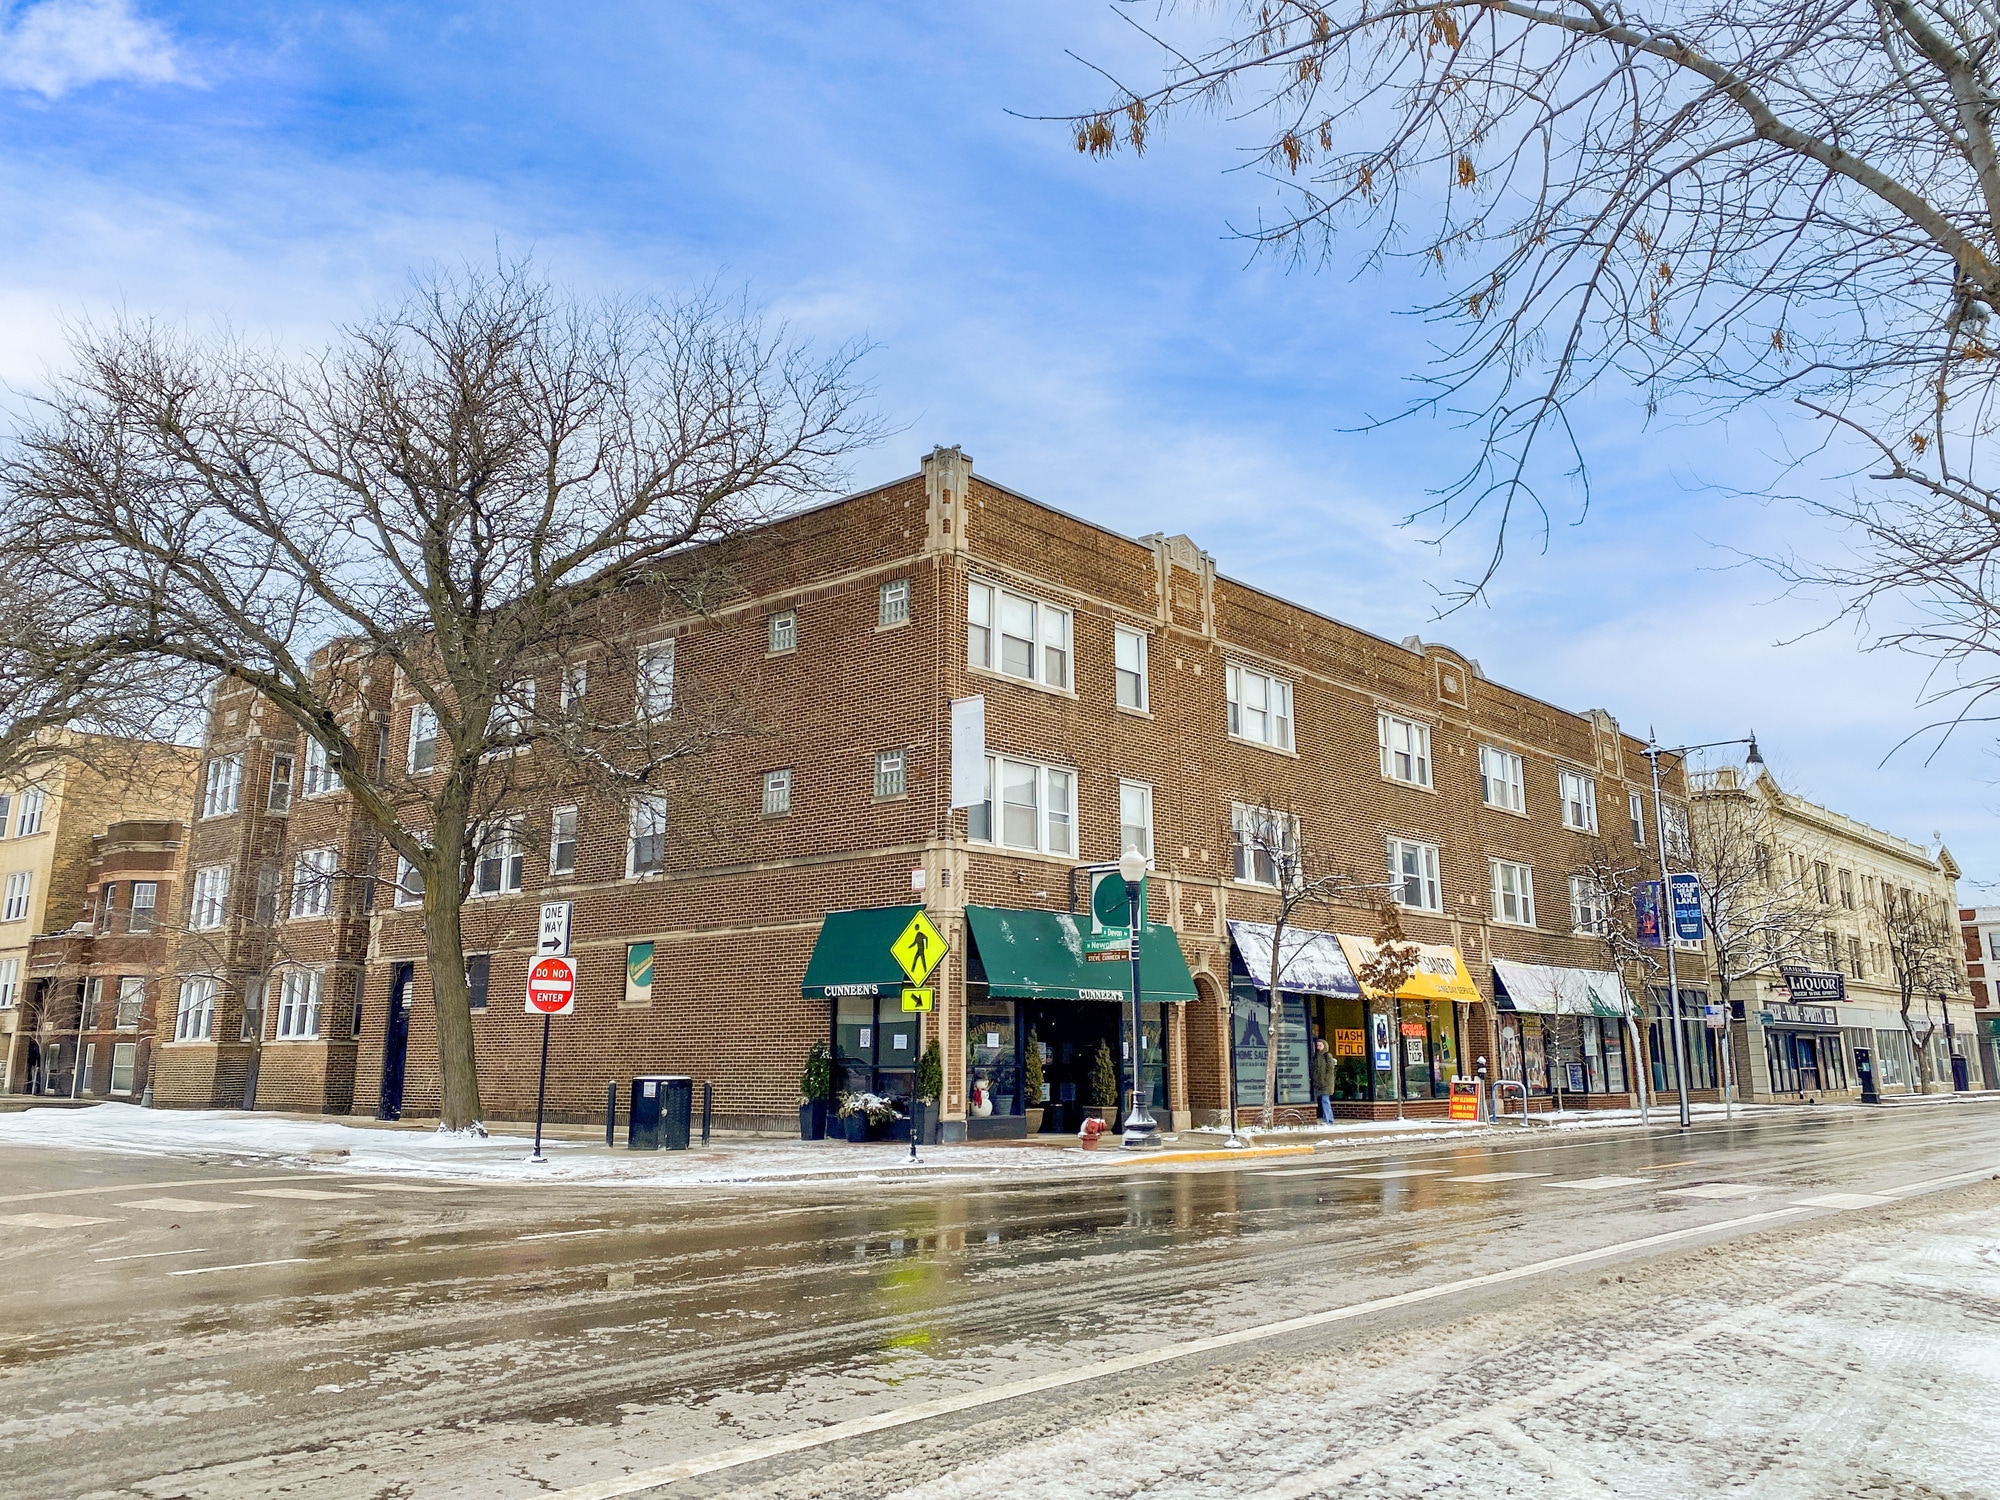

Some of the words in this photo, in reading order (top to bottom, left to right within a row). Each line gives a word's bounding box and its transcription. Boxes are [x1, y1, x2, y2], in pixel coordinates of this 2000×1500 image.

[545, 906, 563, 919] ONE
[544, 921, 563, 933] WAY
[1107, 928, 1122, 936] Devon
[536, 968, 548, 977] DO
[552, 969, 569, 978] NOT
[1789, 976, 1837, 991] LIQUOR
[824, 984, 879, 997] CUNNEEN'S
[1079, 989, 1124, 1001] CUNNEEN'S
[536, 993, 564, 1002] ENTER
[1337, 1031, 1363, 1041] WASH
[1338, 1044, 1364, 1055] FOLD
